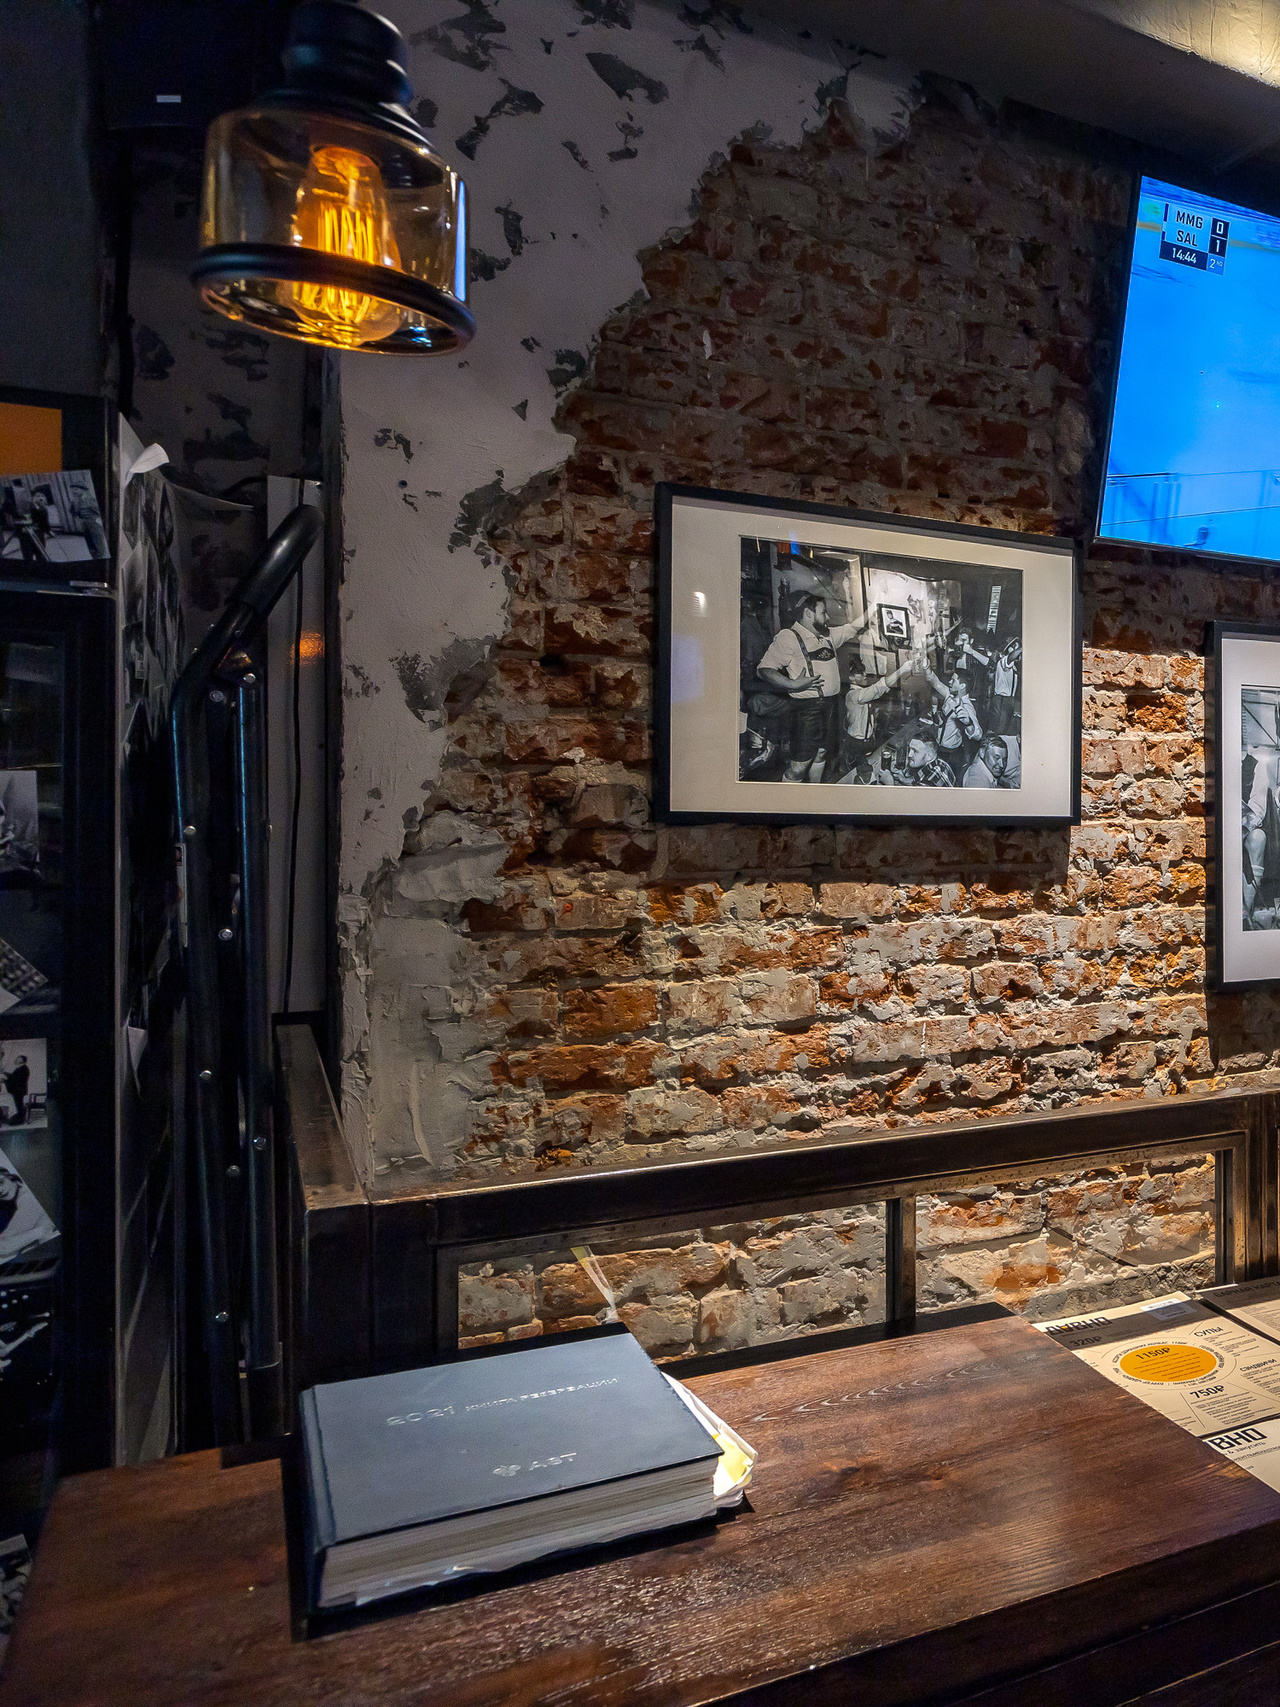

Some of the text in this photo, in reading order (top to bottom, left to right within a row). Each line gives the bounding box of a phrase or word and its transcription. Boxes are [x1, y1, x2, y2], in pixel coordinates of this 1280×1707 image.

[1176, 210, 1224, 235] MMG 0
[1176, 230, 1221, 253] SAL 1
[1172, 247, 1198, 264] 14:44
[1044, 1316, 1113, 1335] ДАВНО
[1194, 1326, 1224, 1337] СУПЫ
[386, 1405, 455, 1426] 2021
[1208, 1427, 1268, 1451] ВНО
